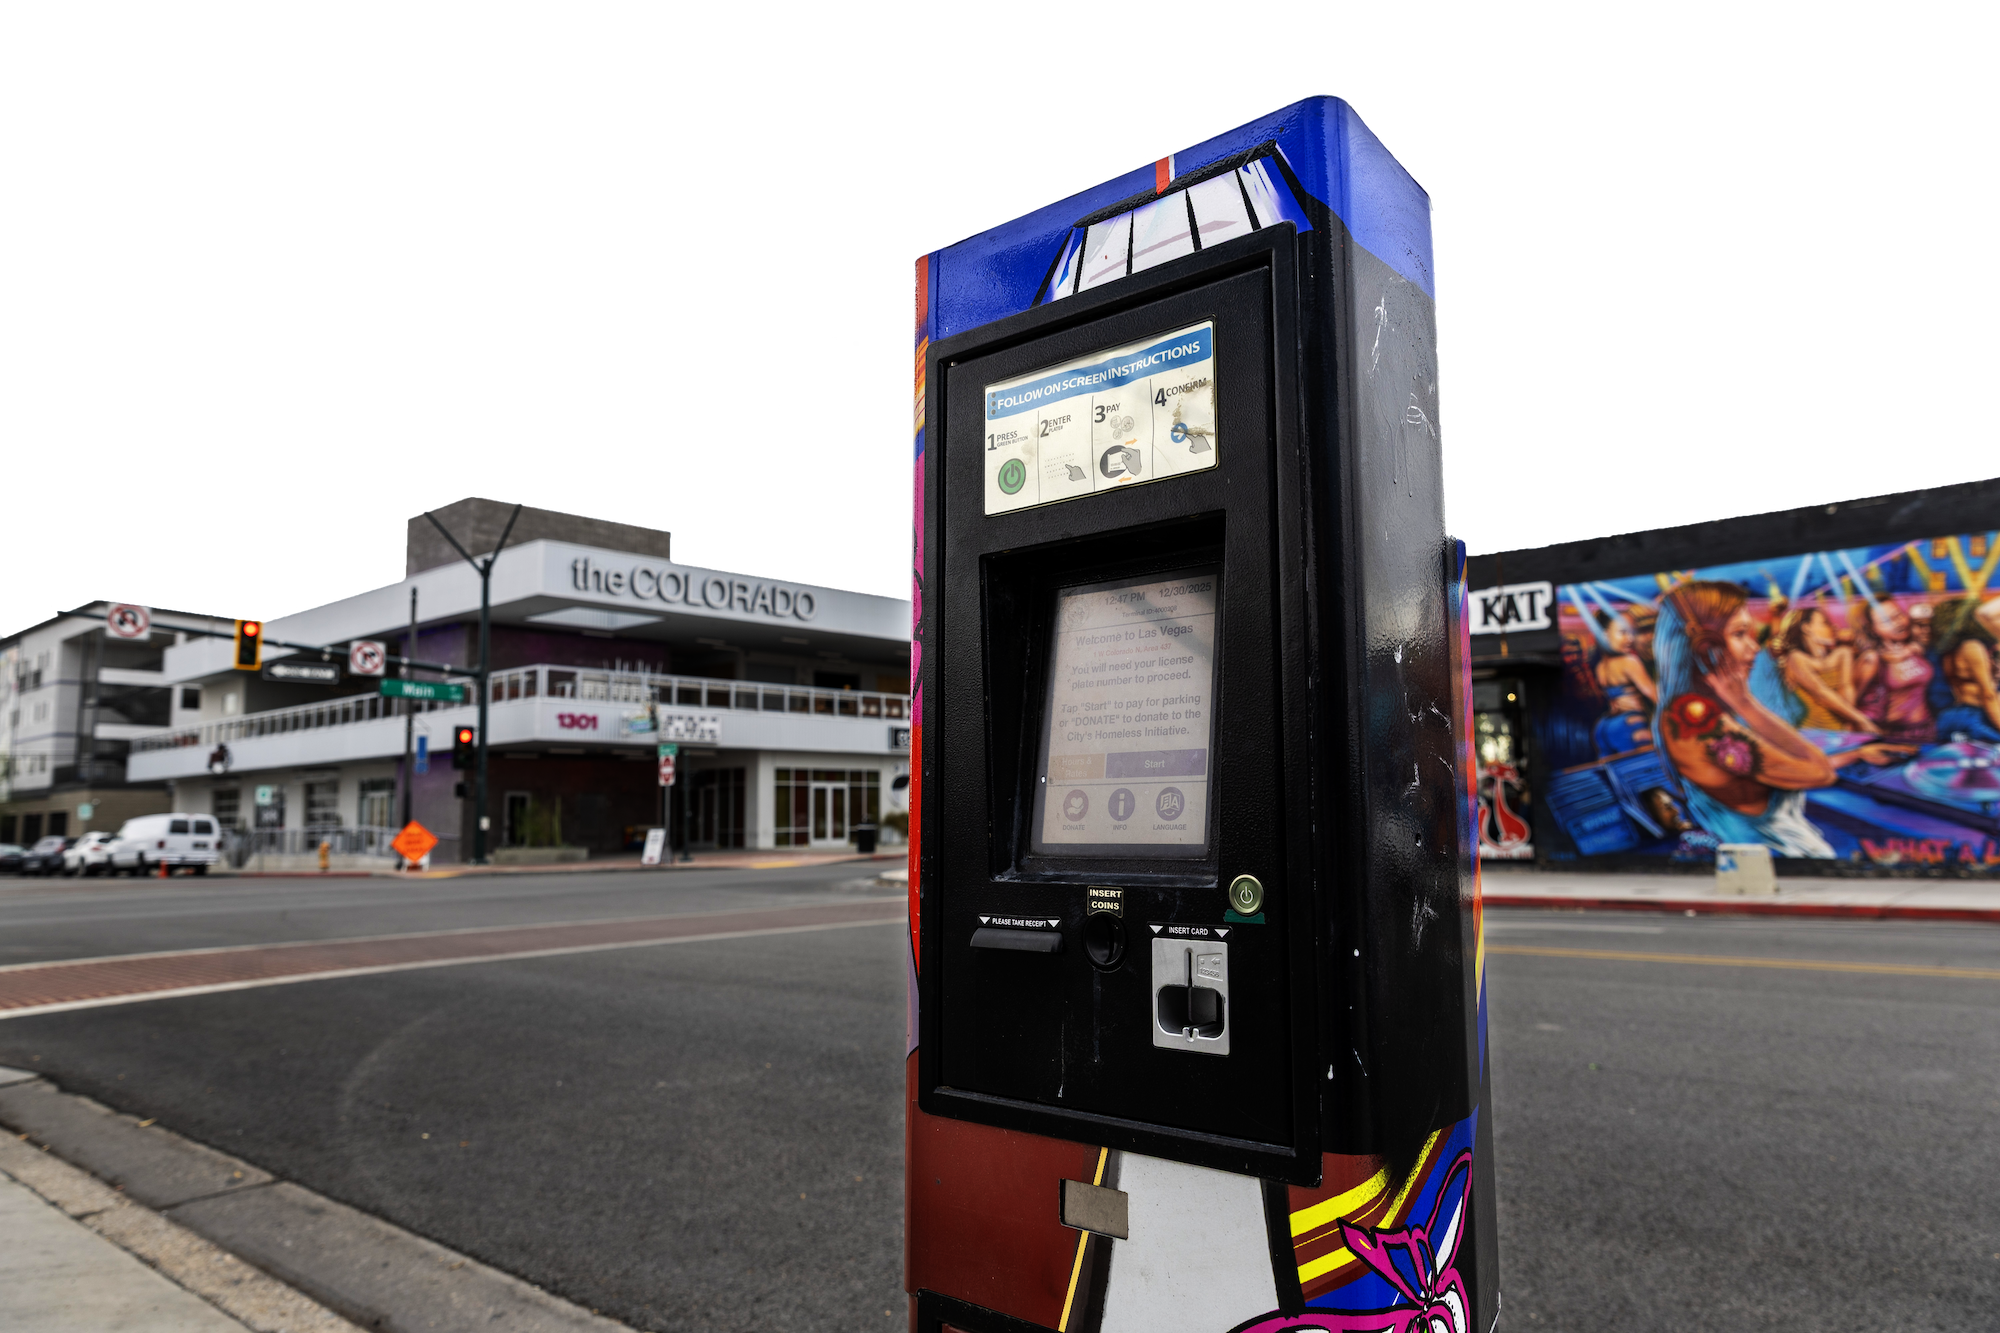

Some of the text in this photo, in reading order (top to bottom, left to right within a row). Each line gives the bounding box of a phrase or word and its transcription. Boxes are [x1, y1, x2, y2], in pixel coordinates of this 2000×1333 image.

[997, 341, 1201, 410] FOLLOW ON SCREEN INSTRUCTIONS
[1154, 378, 1207, 407] 4 CONFIRM
[1094, 403, 1121, 423] 3 PAY
[1040, 414, 1072, 438] 2 ENTER
[987, 430, 1018, 451] 1 PRESS
[996, 435, 1029, 448] GREEN BUTTON
[572, 557, 816, 622] the COLORADO
[1105, 582, 1212, 606] 12:47 PM 12/30/2025
[1122, 608, 1145, 618] Terminal
[1481, 590, 1543, 625] KAT
[1076, 624, 1194, 647] Welcome to Las Vegas
[1105, 648, 1134, 656] Colorado
[1071, 655, 1194, 675] You will need your license
[1071, 669, 1191, 691] plate number to proceed.
[1061, 693, 1201, 715] Tap "Start" to pay for parking
[557, 713, 598, 729] 1301
[1059, 709, 1201, 728] or "DONATE" to donate to the
[1067, 725, 1190, 743] City's Homeless Initiative.
[1061, 756, 1092, 766] Hours &
[1144, 759, 1165, 769] Start
[1065, 769, 1087, 778] Rates
[1089, 889, 1122, 898] INSERT
[1091, 901, 1120, 910] COINS
[992, 917, 1047, 928] PLEASE TAKE RECEIPT
[1168, 926, 1209, 936] INSERT CARD
